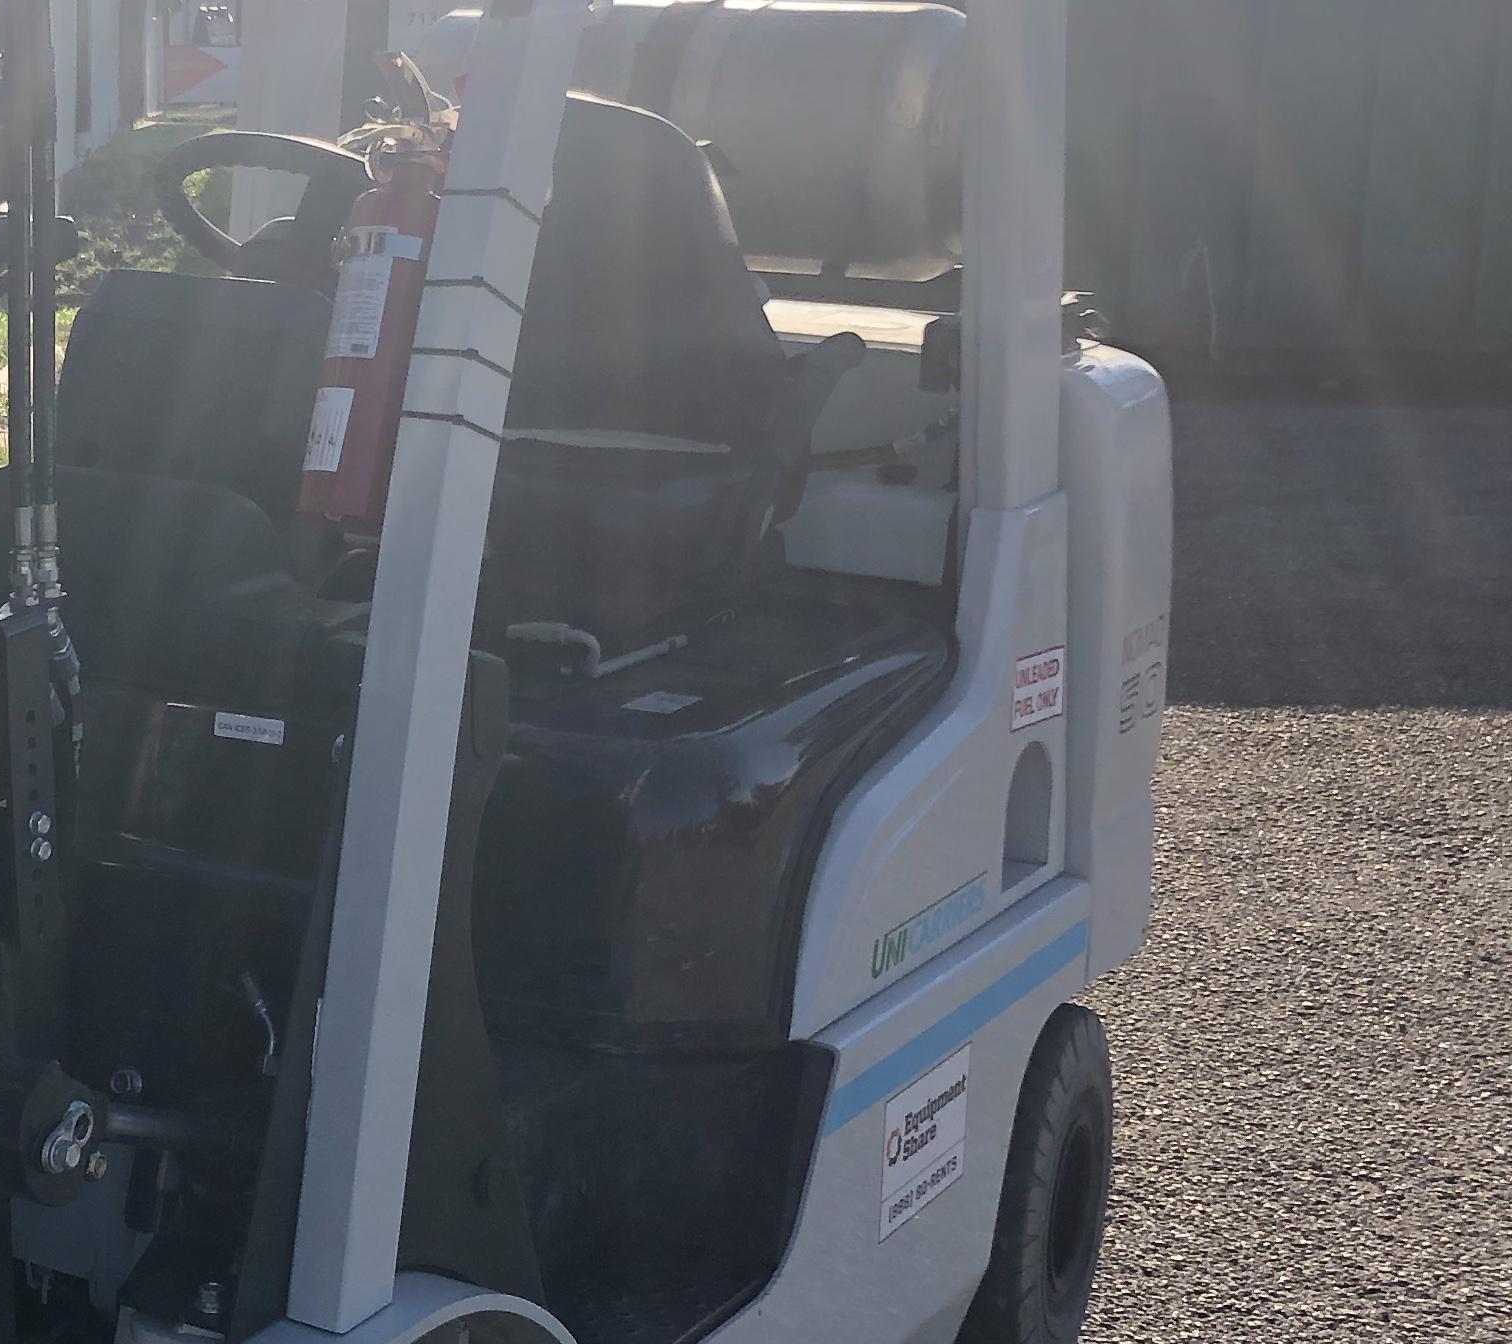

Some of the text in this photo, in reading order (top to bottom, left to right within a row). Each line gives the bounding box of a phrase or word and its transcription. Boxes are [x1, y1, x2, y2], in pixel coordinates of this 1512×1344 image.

[1015, 658, 1060, 689] UNLEADED
[1014, 687, 1061, 718] FUEL ONLY
[904, 1073, 968, 1137] Equipment
[902, 1122, 938, 1162] Share
